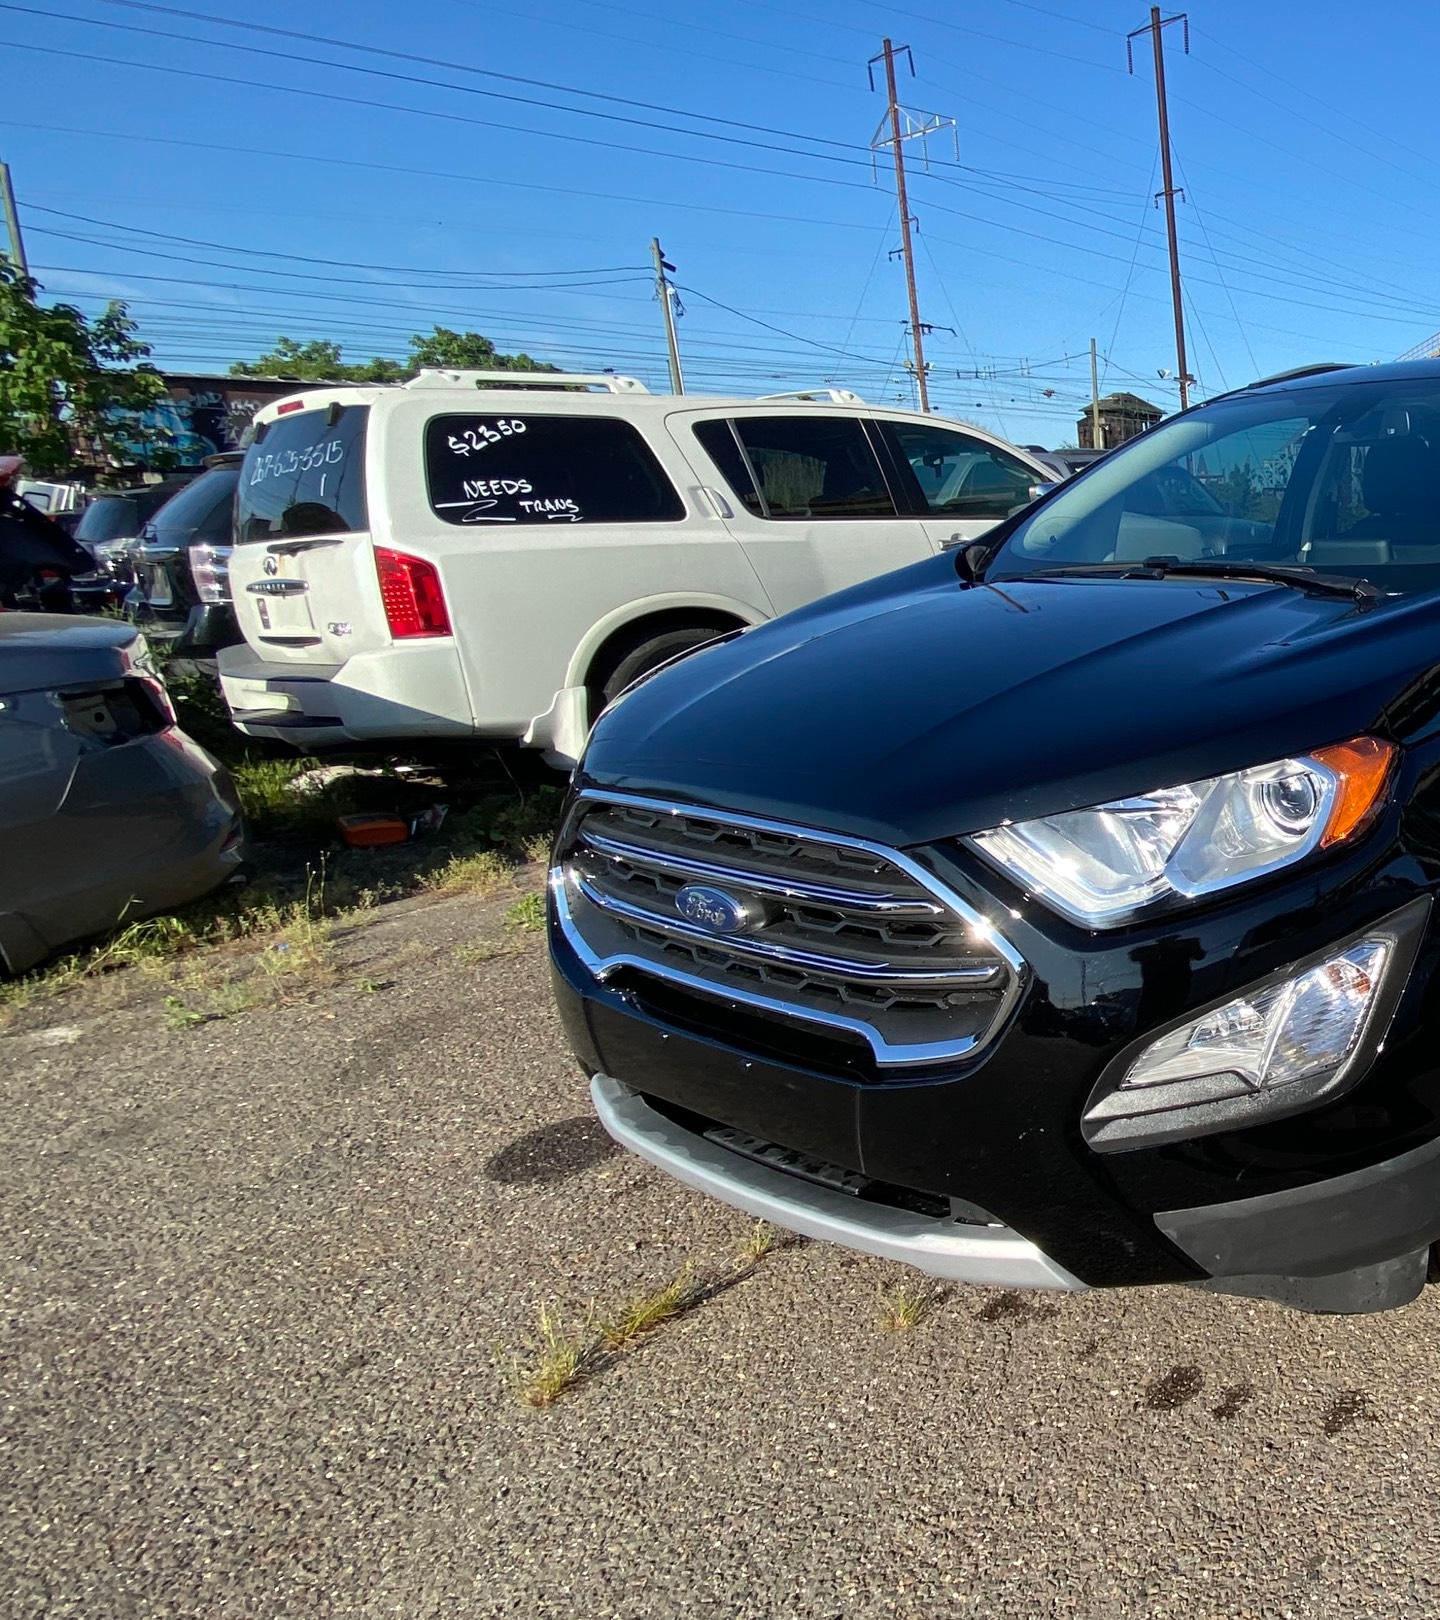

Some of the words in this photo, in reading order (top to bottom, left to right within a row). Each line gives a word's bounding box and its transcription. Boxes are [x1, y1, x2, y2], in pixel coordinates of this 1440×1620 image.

[448, 419, 526, 456] $2350
[463, 479, 533, 499] NEEDS
[519, 498, 580, 513] TRANS
[686, 891, 727, 926] Ford
